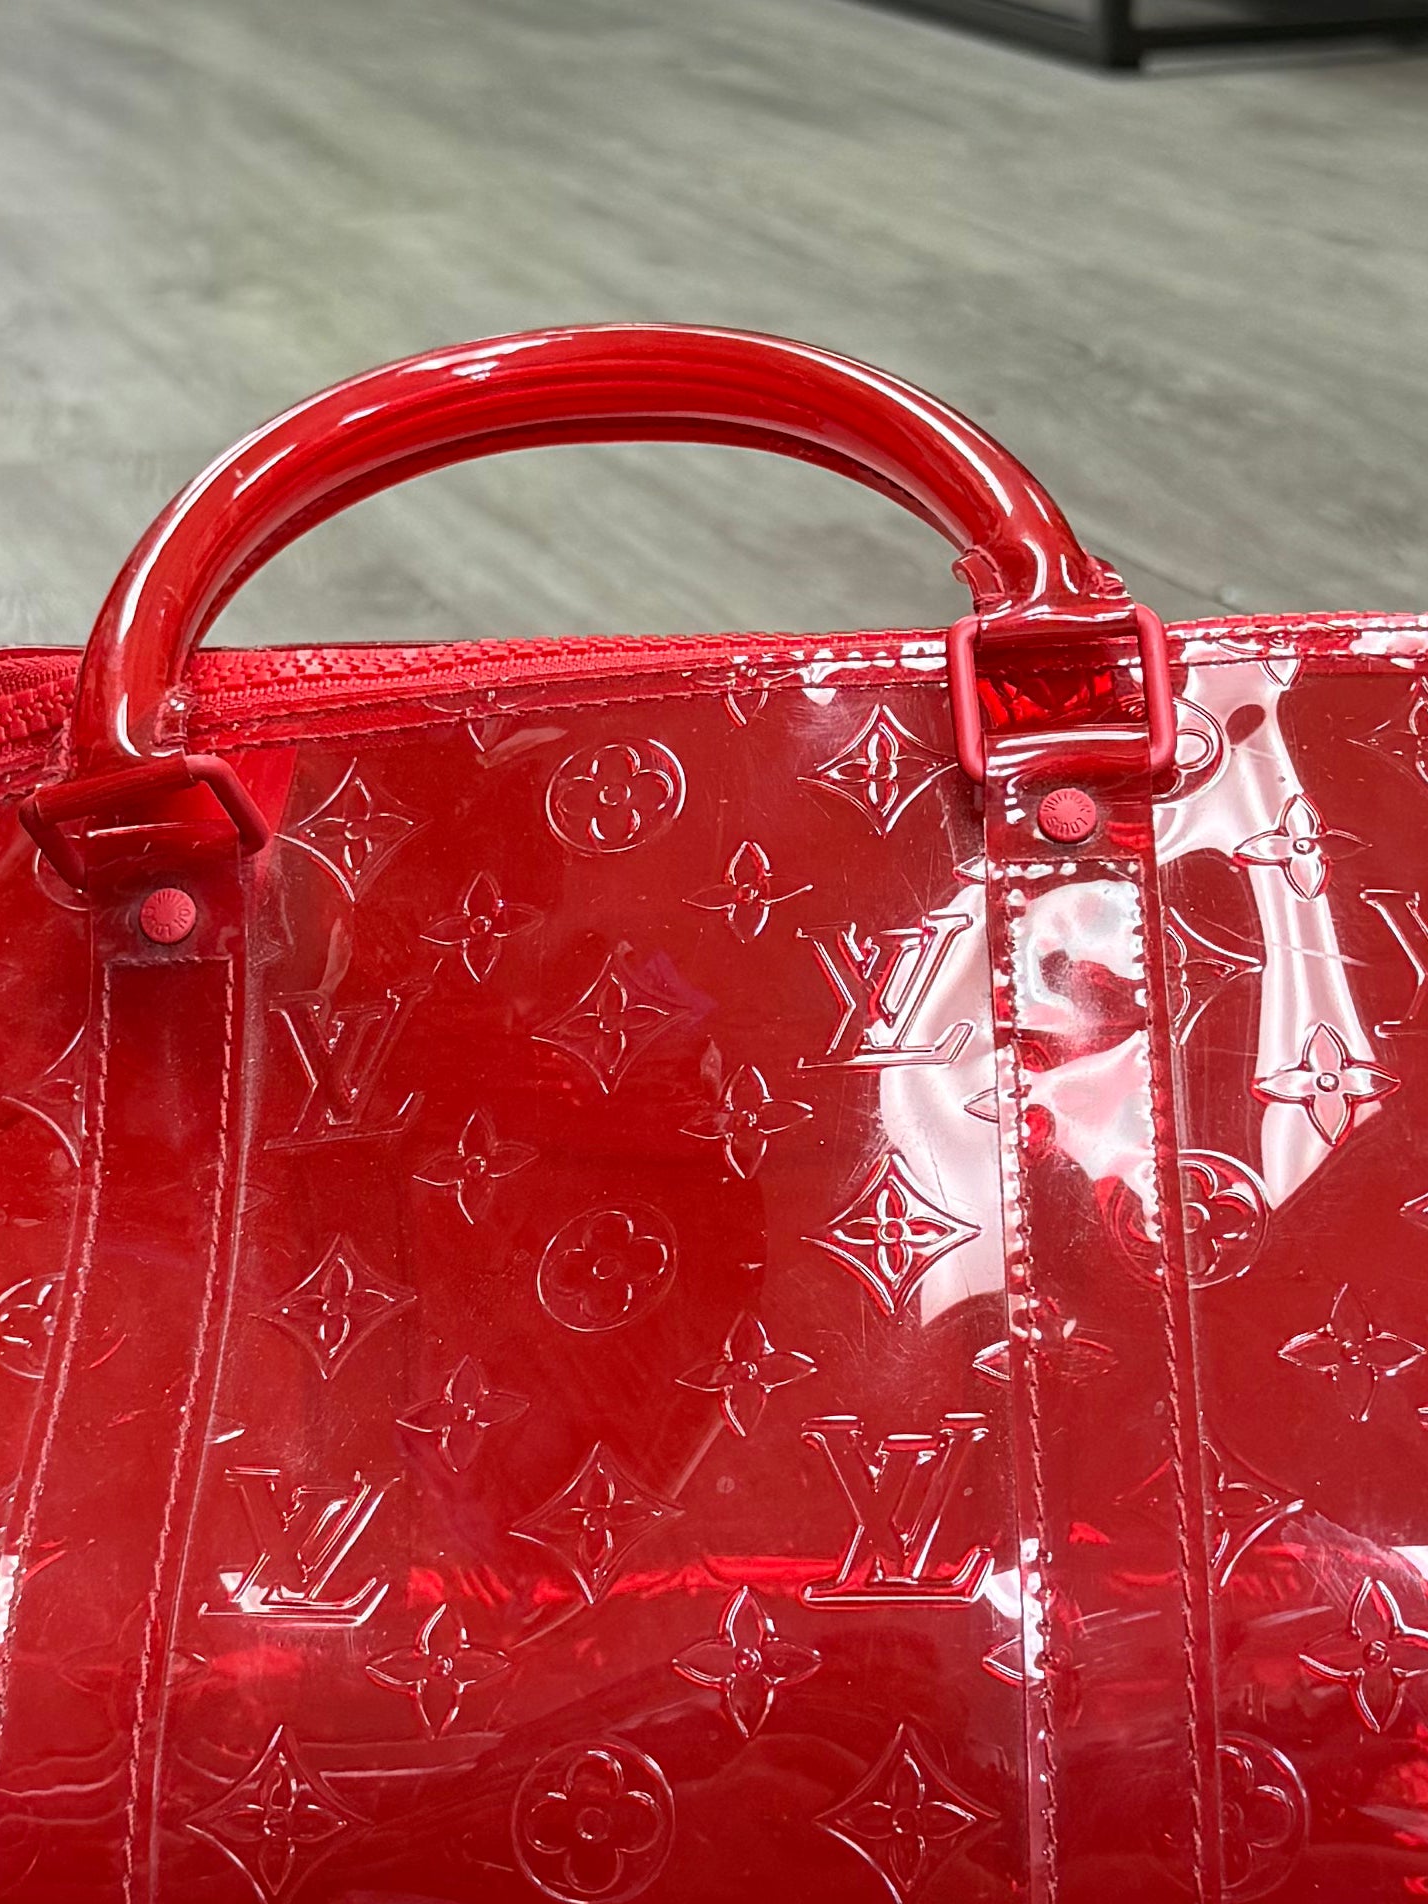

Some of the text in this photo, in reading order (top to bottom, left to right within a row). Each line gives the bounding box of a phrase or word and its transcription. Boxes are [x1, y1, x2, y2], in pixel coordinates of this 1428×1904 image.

[264, 982, 430, 1151] LV
[797, 912, 975, 1070] LV
[200, 1467, 401, 1627] LV
[802, 1413, 994, 1605] LV
